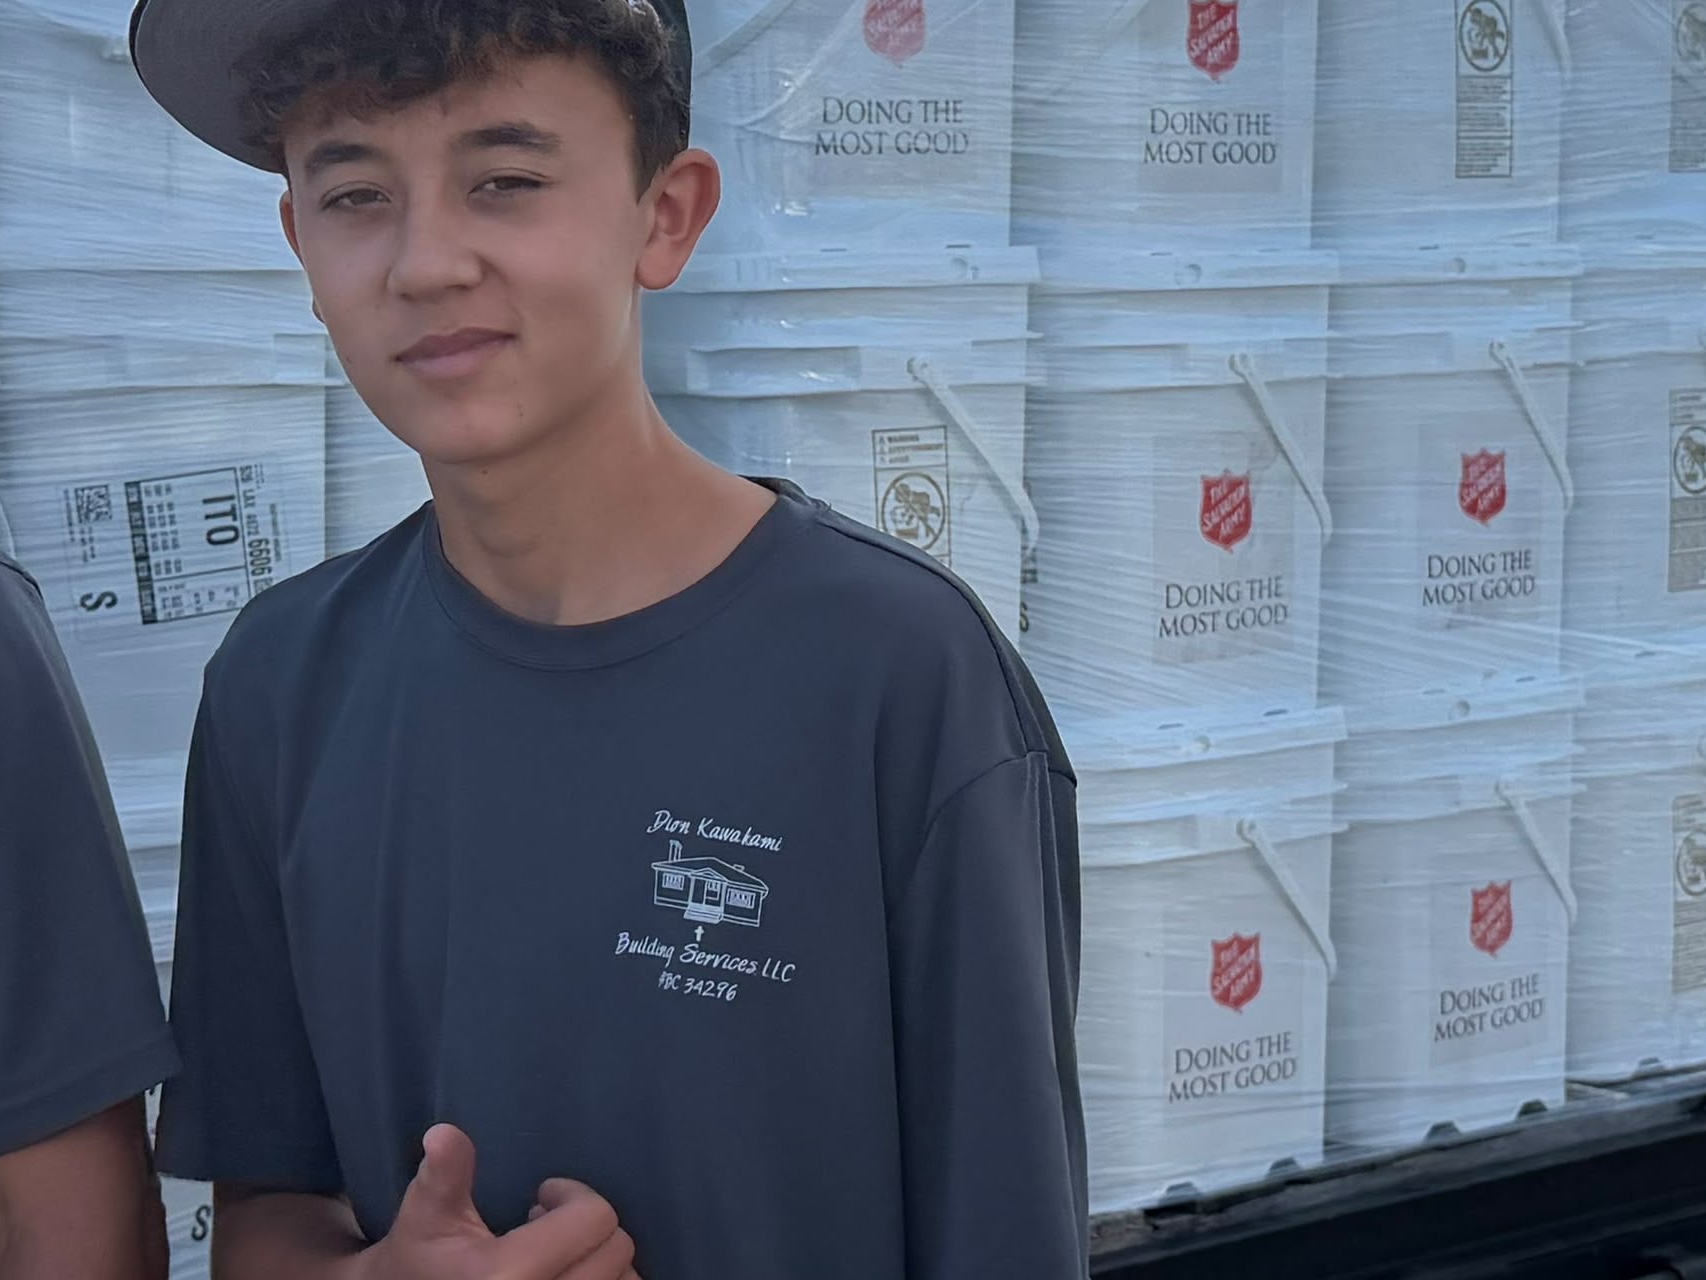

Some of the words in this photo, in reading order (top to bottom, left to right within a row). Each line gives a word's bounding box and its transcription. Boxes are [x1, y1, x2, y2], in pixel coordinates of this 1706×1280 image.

[822, 96, 912, 124] DOING
[918, 99, 964, 123] THE
[1150, 108, 1228, 136] DOING
[1234, 113, 1272, 136] THE
[815, 130, 890, 156] MOST
[894, 130, 969, 155] GOOD
[1143, 141, 1207, 165] MOST
[1212, 141, 1277, 165] GOOD
[202, 494, 240, 546] ITO
[248, 538, 273, 576] 6606
[1427, 552, 1496, 579] DOING
[1500, 548, 1533, 573] THE
[80, 590, 118, 612] S
[1165, 580, 1243, 609] DOING
[1245, 575, 1285, 602] THE
[1422, 581, 1477, 607] MOST
[1481, 574, 1536, 601] GOOD
[1158, 609, 1222, 639] MOST
[1225, 602, 1289, 632] GOOD
[646, 809, 691, 835] Dion
[696, 817, 784, 852] Kawakami
[614, 931, 675, 969] Building
[761, 957, 796, 983] LLC
[684, 977, 739, 1002] 34296
[1439, 982, 1506, 1016] DOING
[1508, 972, 1540, 1000] THE
[1434, 1012, 1488, 1043] MOST
[1490, 997, 1546, 1030] GOOD
[1174, 1039, 1252, 1075] DOING
[1255, 1030, 1292, 1058] THE
[1168, 1070, 1233, 1105] MOST
[1234, 1056, 1299, 1090] GOOD
[191, 1204, 211, 1241] S
